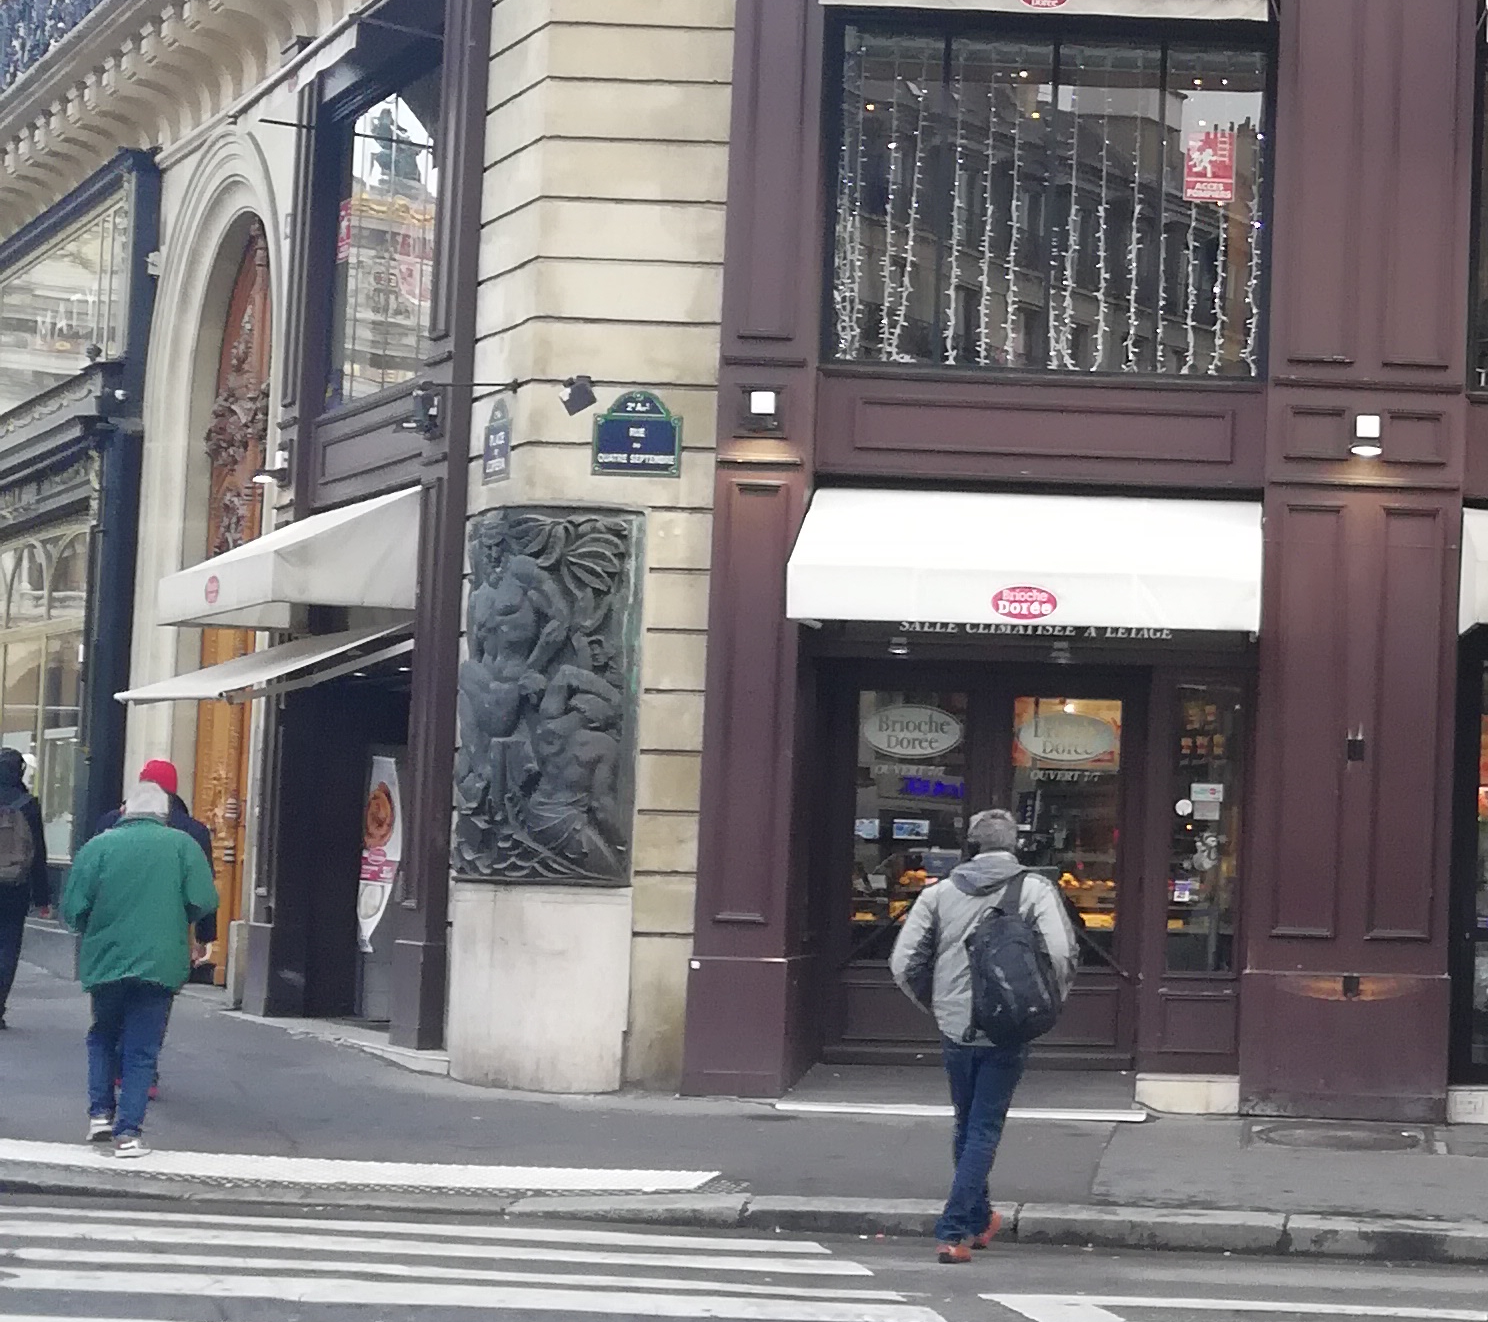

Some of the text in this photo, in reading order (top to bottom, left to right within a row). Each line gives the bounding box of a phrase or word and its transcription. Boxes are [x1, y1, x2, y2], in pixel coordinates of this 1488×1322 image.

[628, 427, 646, 438] RUE
[597, 452, 628, 464] QUATRE
[1002, 588, 1049, 601] Brioche
[997, 600, 1054, 615] Dorée
[878, 714, 951, 737] Brioche
